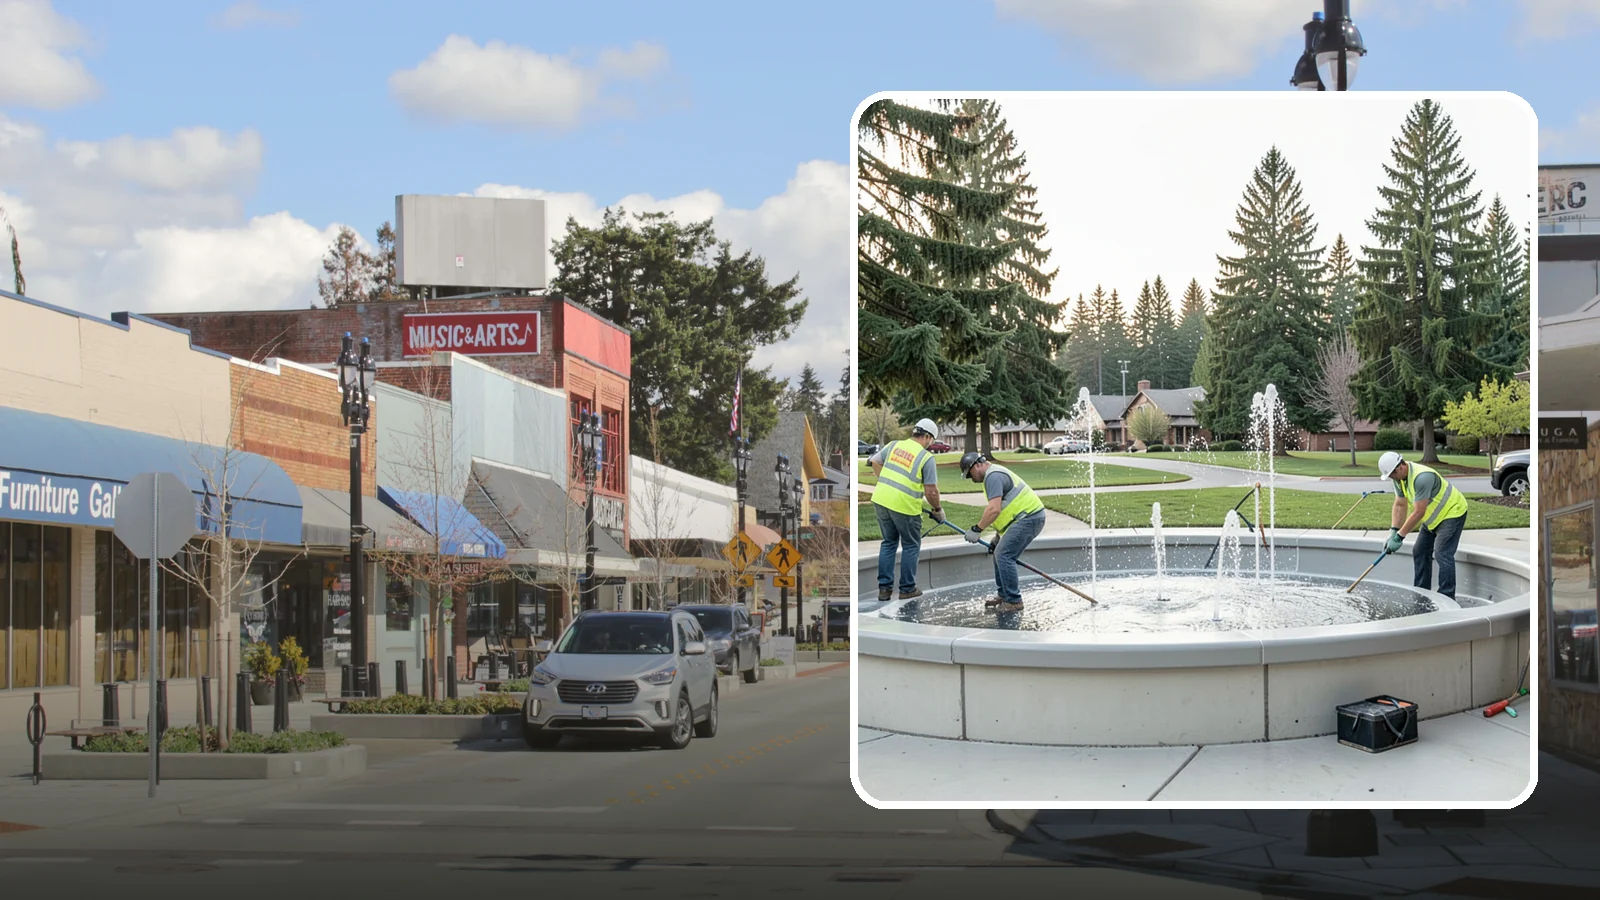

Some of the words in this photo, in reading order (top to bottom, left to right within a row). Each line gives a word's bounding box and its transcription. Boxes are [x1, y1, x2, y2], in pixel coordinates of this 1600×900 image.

[408, 323, 520, 349] MUSIC&ARTS
[1540, 427, 1578, 437] UGA
[0, 471, 80, 515] Furniture
[89, 482, 122, 519] Gal
